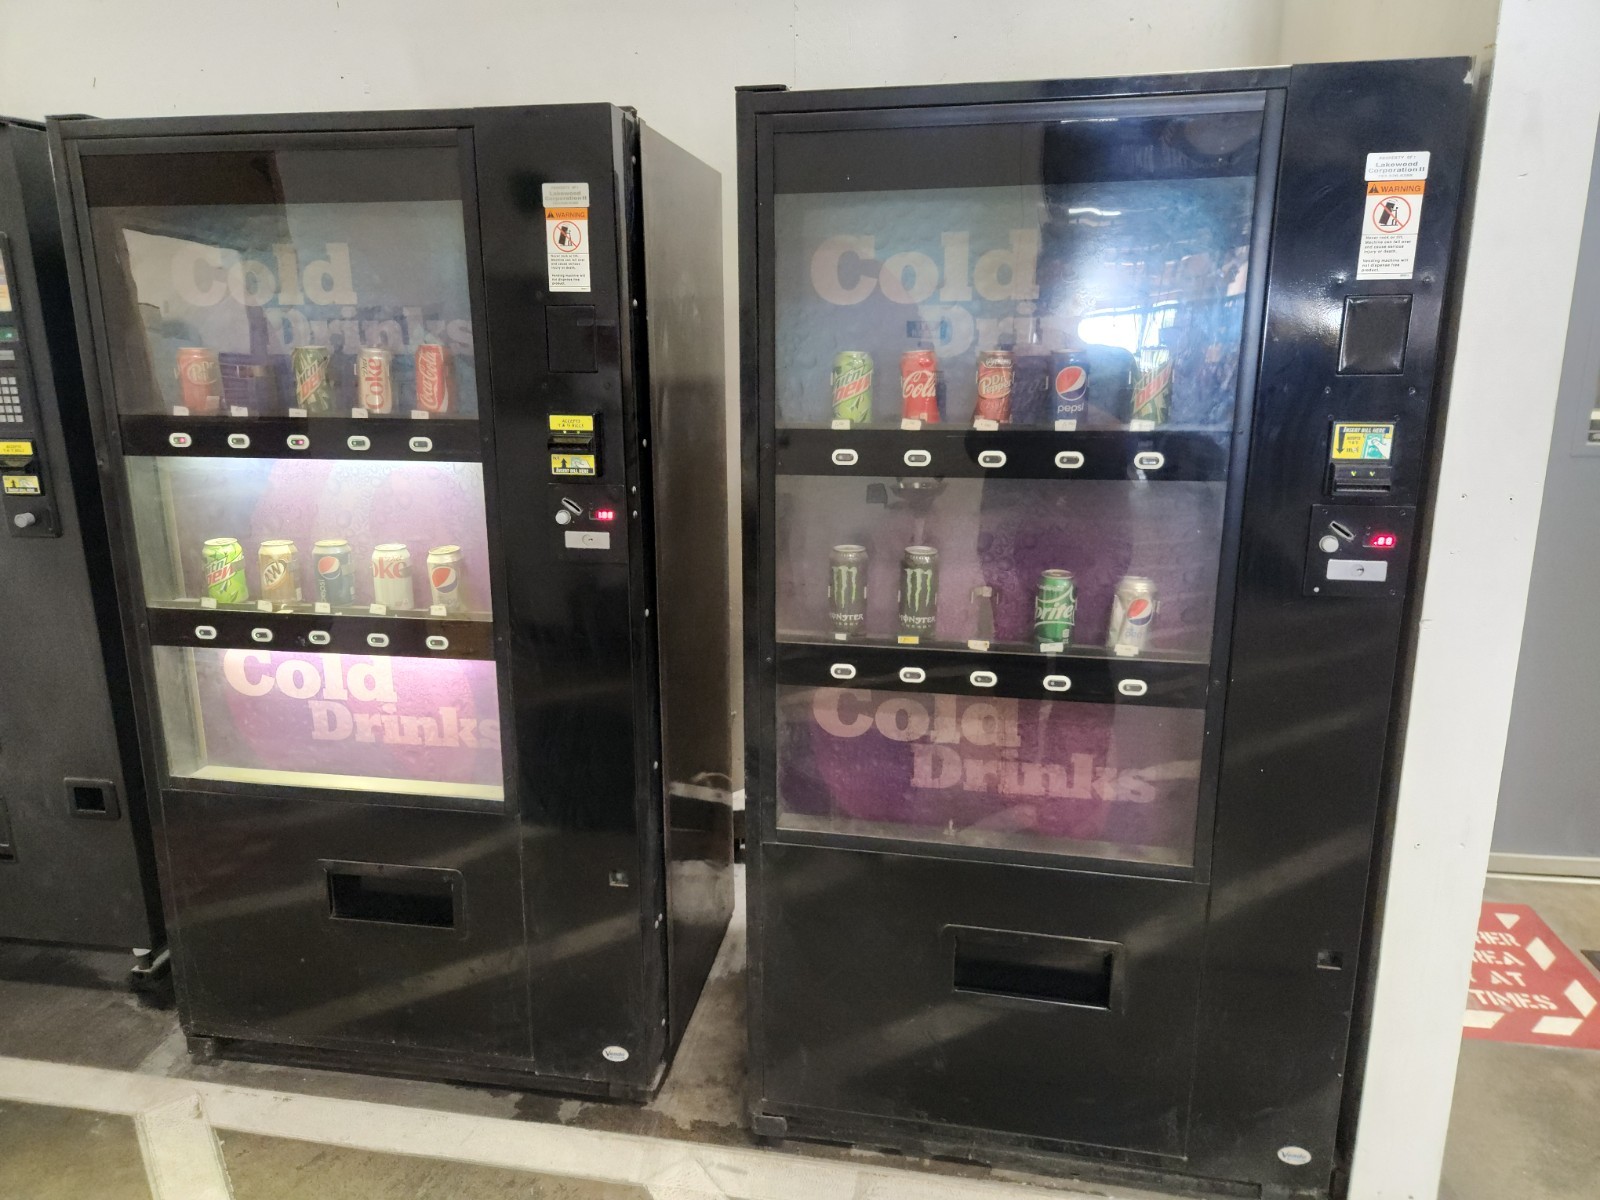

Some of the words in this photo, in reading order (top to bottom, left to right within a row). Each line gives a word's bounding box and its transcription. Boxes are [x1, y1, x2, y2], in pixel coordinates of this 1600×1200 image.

[1380, 185, 1421, 193] WARNING
[172, 242, 357, 306] Cold
[809, 228, 1040, 306] Cold
[266, 306, 473, 356] Drinks
[365, 358, 384, 409] Coke
[1058, 402, 1084, 413] pepsi
[223, 649, 398, 702] Cold
[307, 699, 501, 750] Drinks
[812, 685, 1021, 747] Cold
[910, 743, 1156, 803] Drinks
[1469, 988, 1559, 1011] TIMES
